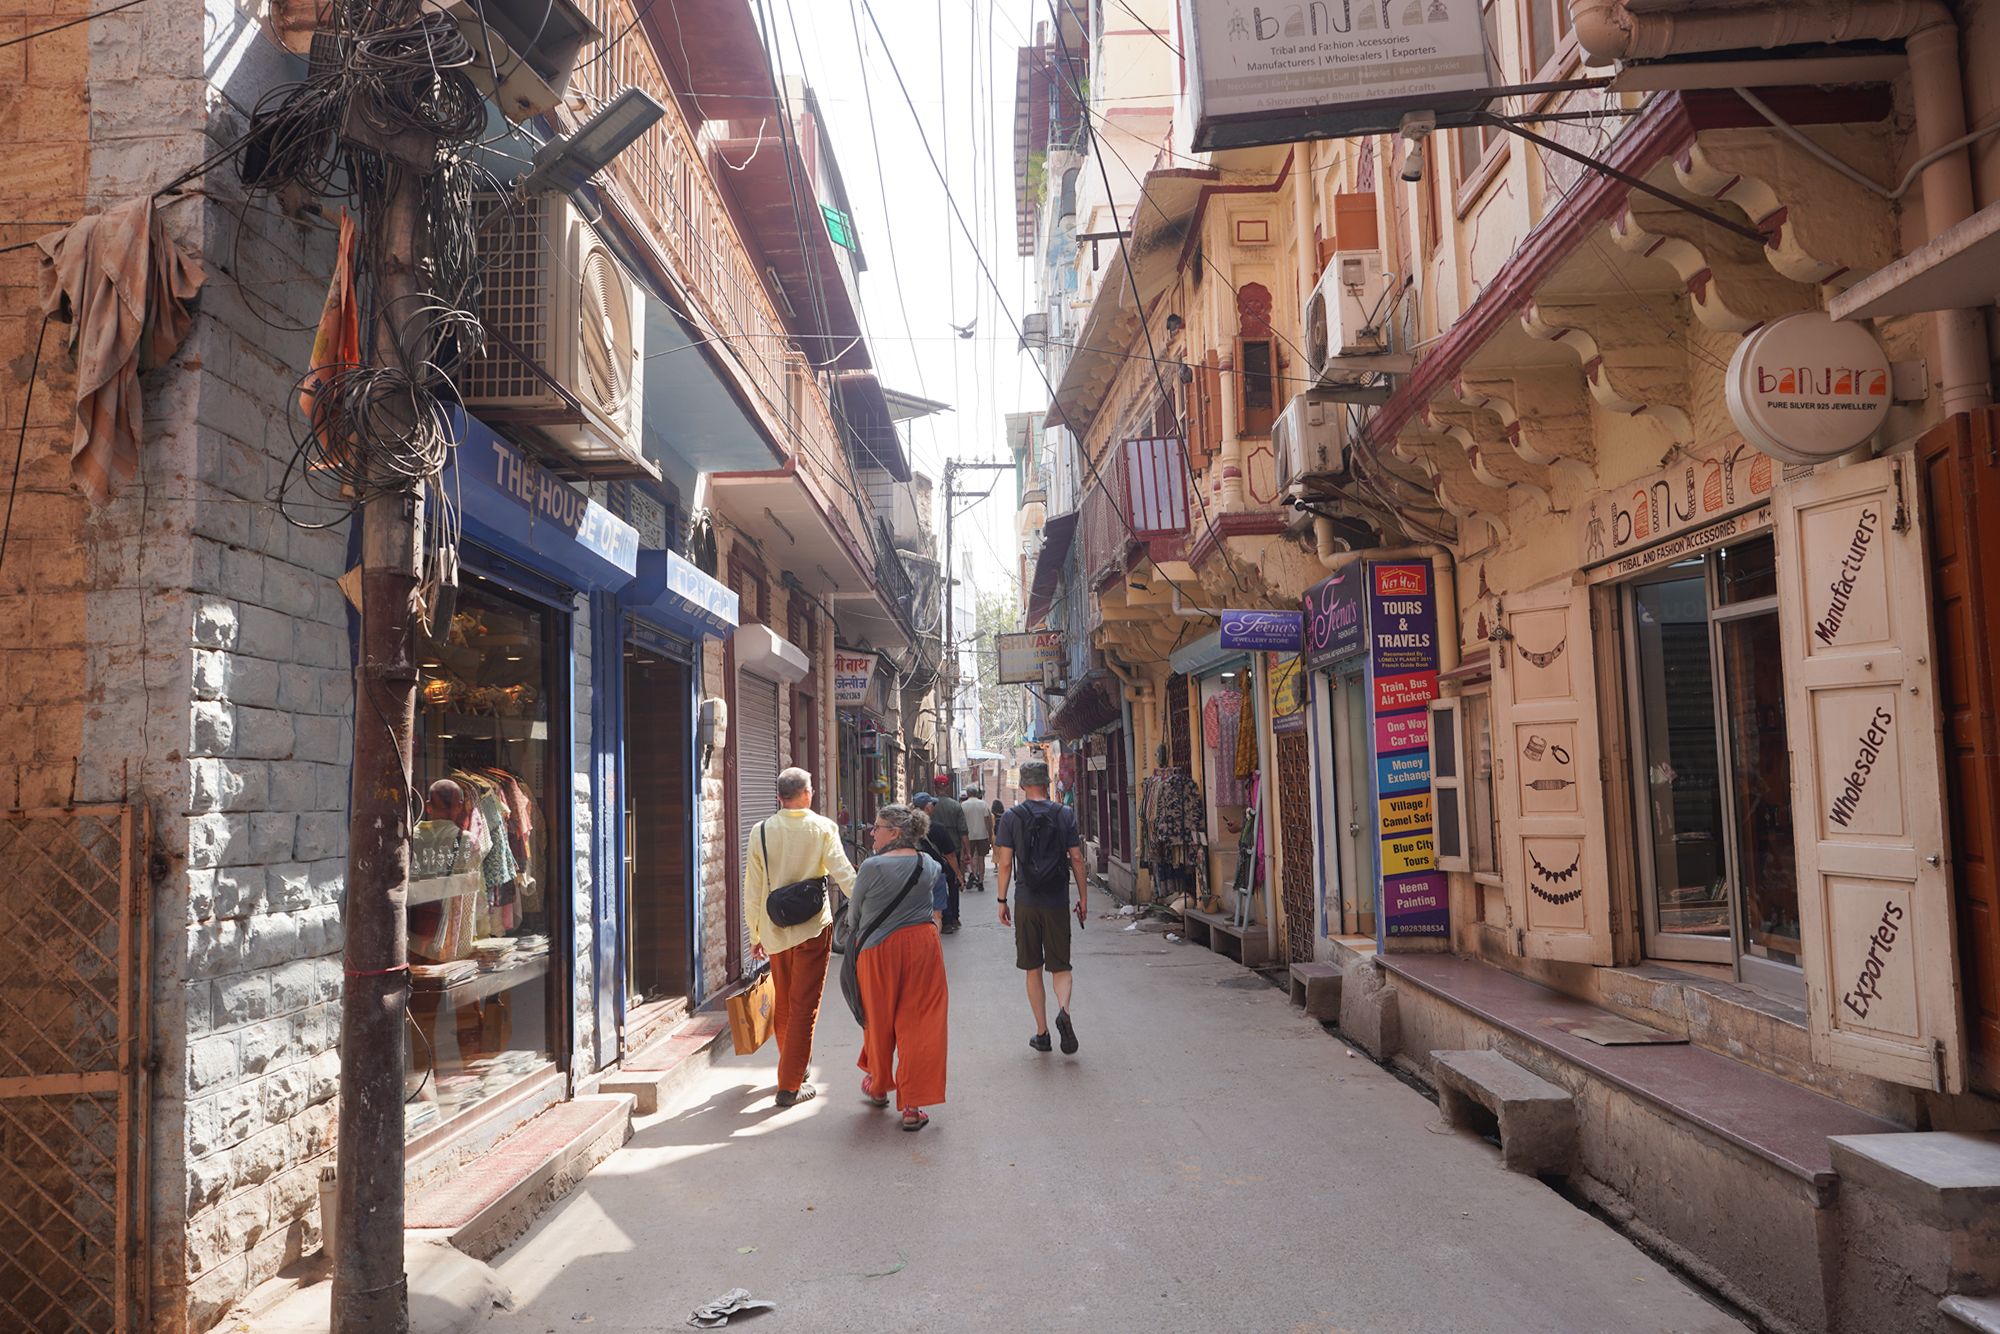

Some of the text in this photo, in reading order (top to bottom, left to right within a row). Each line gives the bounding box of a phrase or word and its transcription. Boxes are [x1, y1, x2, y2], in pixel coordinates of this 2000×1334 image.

[1270, 45, 1297, 56] Tribal
[1298, 44, 1316, 53] and
[1247, 58, 1316, 71] Manufacturers
[1325, 52, 1382, 65] Wholesalers
[1392, 46, 1437, 59] Exporters
[1366, 88, 1385, 97] Arts
[1388, 86, 1406, 95] and
[1408, 82, 1436, 92] Crafts
[1767, 401, 1788, 409] PURE
[1817, 402, 1830, 410] 925
[1831, 402, 1877, 410] JEWELLERY
[492, 441, 535, 504] THE
[539, 475, 598, 542] HOUSE
[601, 519, 622, 557] OF
[1618, 558, 1642, 574] TRIBAL
[1643, 553, 1656, 567] AND
[1657, 541, 1685, 560] FASHION
[1686, 520, 1737, 550] ACCESSORIES
[1382, 575, 1416, 590] NET HUT
[1814, 508, 1877, 647] Manufacturers
[1315, 575, 1358, 648] Feena's
[1382, 601, 1423, 615] TOURS
[1224, 613, 1297, 636] Feena's
[1398, 617, 1408, 631] &
[1377, 633, 1431, 648] TRAVELS
[1380, 679, 1428, 693] Train, Bus
[1381, 690, 1431, 706] Air Tickets
[1387, 719, 1427, 733] One Way
[1391, 731, 1428, 747] Car Taxi
[1392, 759, 1424, 771] Money
[1829, 705, 1892, 829] Wholesalers
[1387, 770, 1431, 784] Exchange
[1390, 800, 1424, 812] Village
[1383, 812, 1433, 828] Camel Safa
[1393, 839, 1434, 854] Blue City
[1404, 856, 1429, 867] Tours
[1399, 882, 1429, 894] Heena
[1396, 895, 1437, 909] Painting
[1842, 900, 1904, 1021] Exporters
